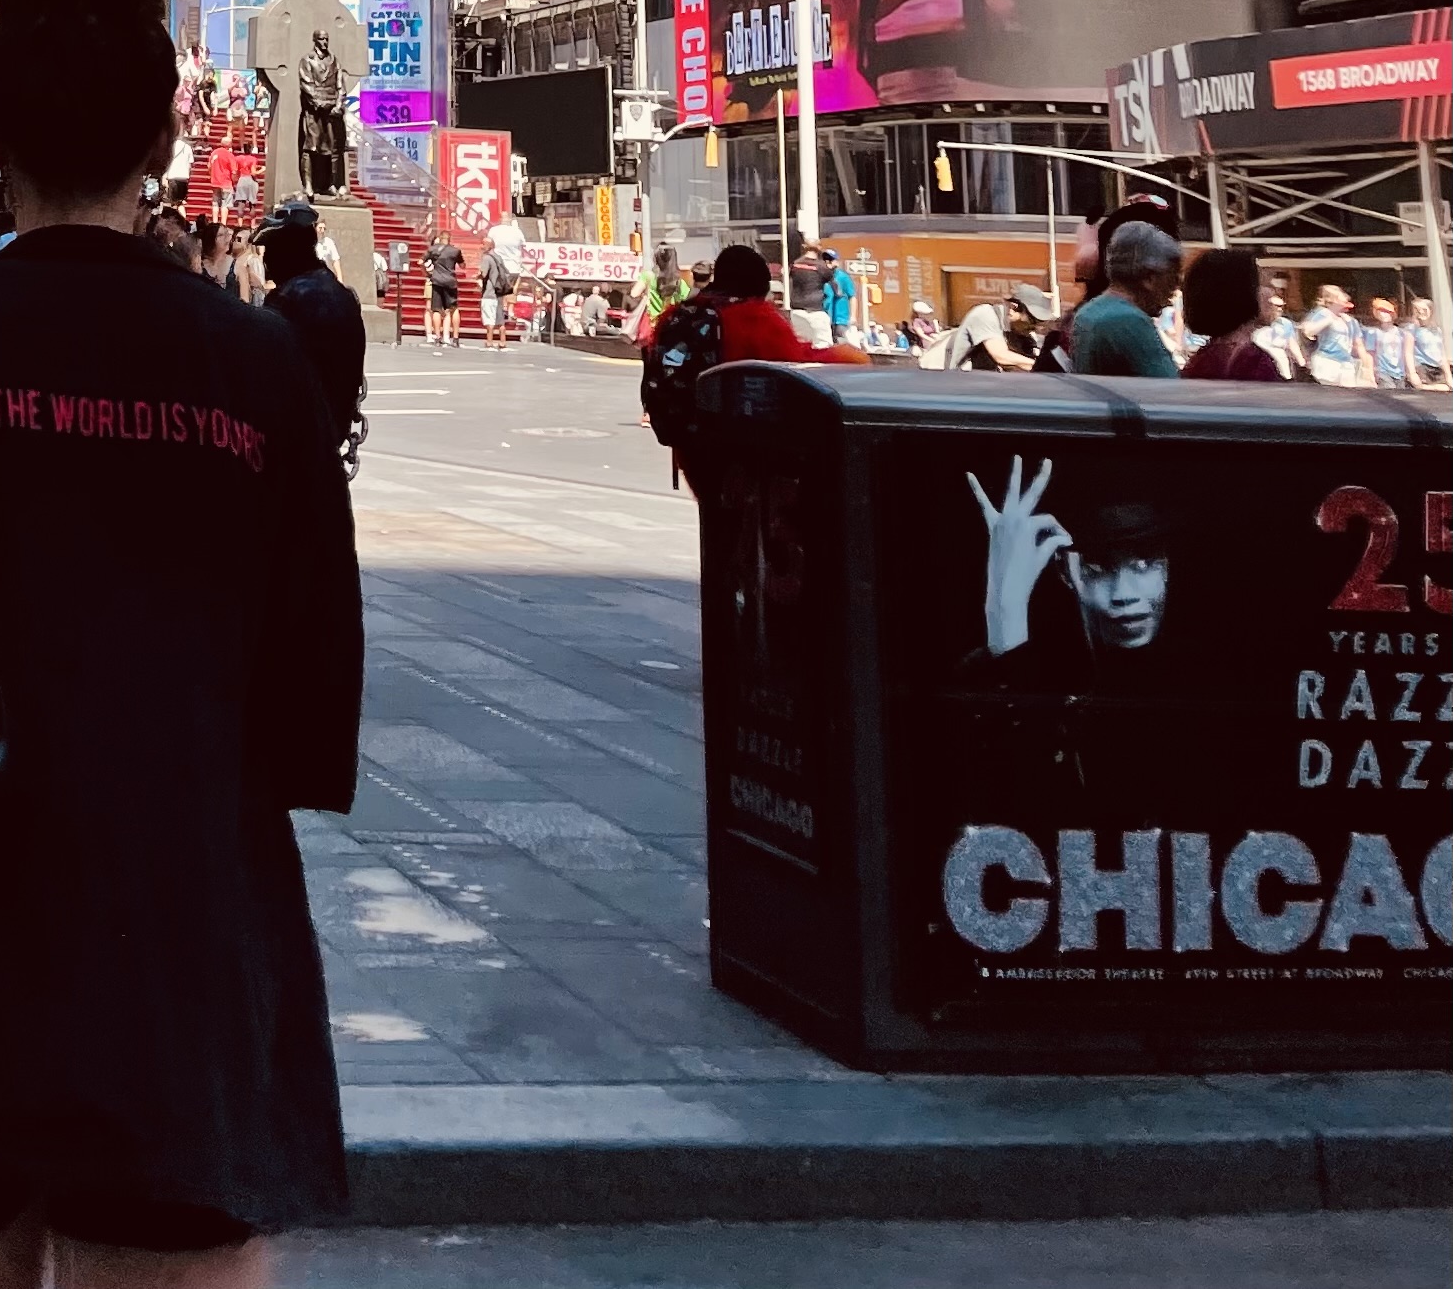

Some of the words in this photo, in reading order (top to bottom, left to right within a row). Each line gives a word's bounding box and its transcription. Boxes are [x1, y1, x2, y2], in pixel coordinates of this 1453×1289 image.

[370, 11, 393, 19] CAT
[394, 11, 411, 19] ON
[368, 18, 423, 38] HOT
[368, 40, 421, 62] TIN
[369, 62, 421, 77] ROOF
[1298, 66, 1336, 93] 1568
[1339, 58, 1440, 89] BROADWAY
[1178, 71, 1255, 119] BROADWAY
[376, 105, 412, 125] $39
[456, 141, 499, 231] tkts
[599, 188, 611, 245] LUGGAGE
[557, 246, 594, 261] Sale
[51, 394, 153, 440] WORLD
[159, 402, 187, 442] IS
[1329, 631, 1439, 655] YEARS
